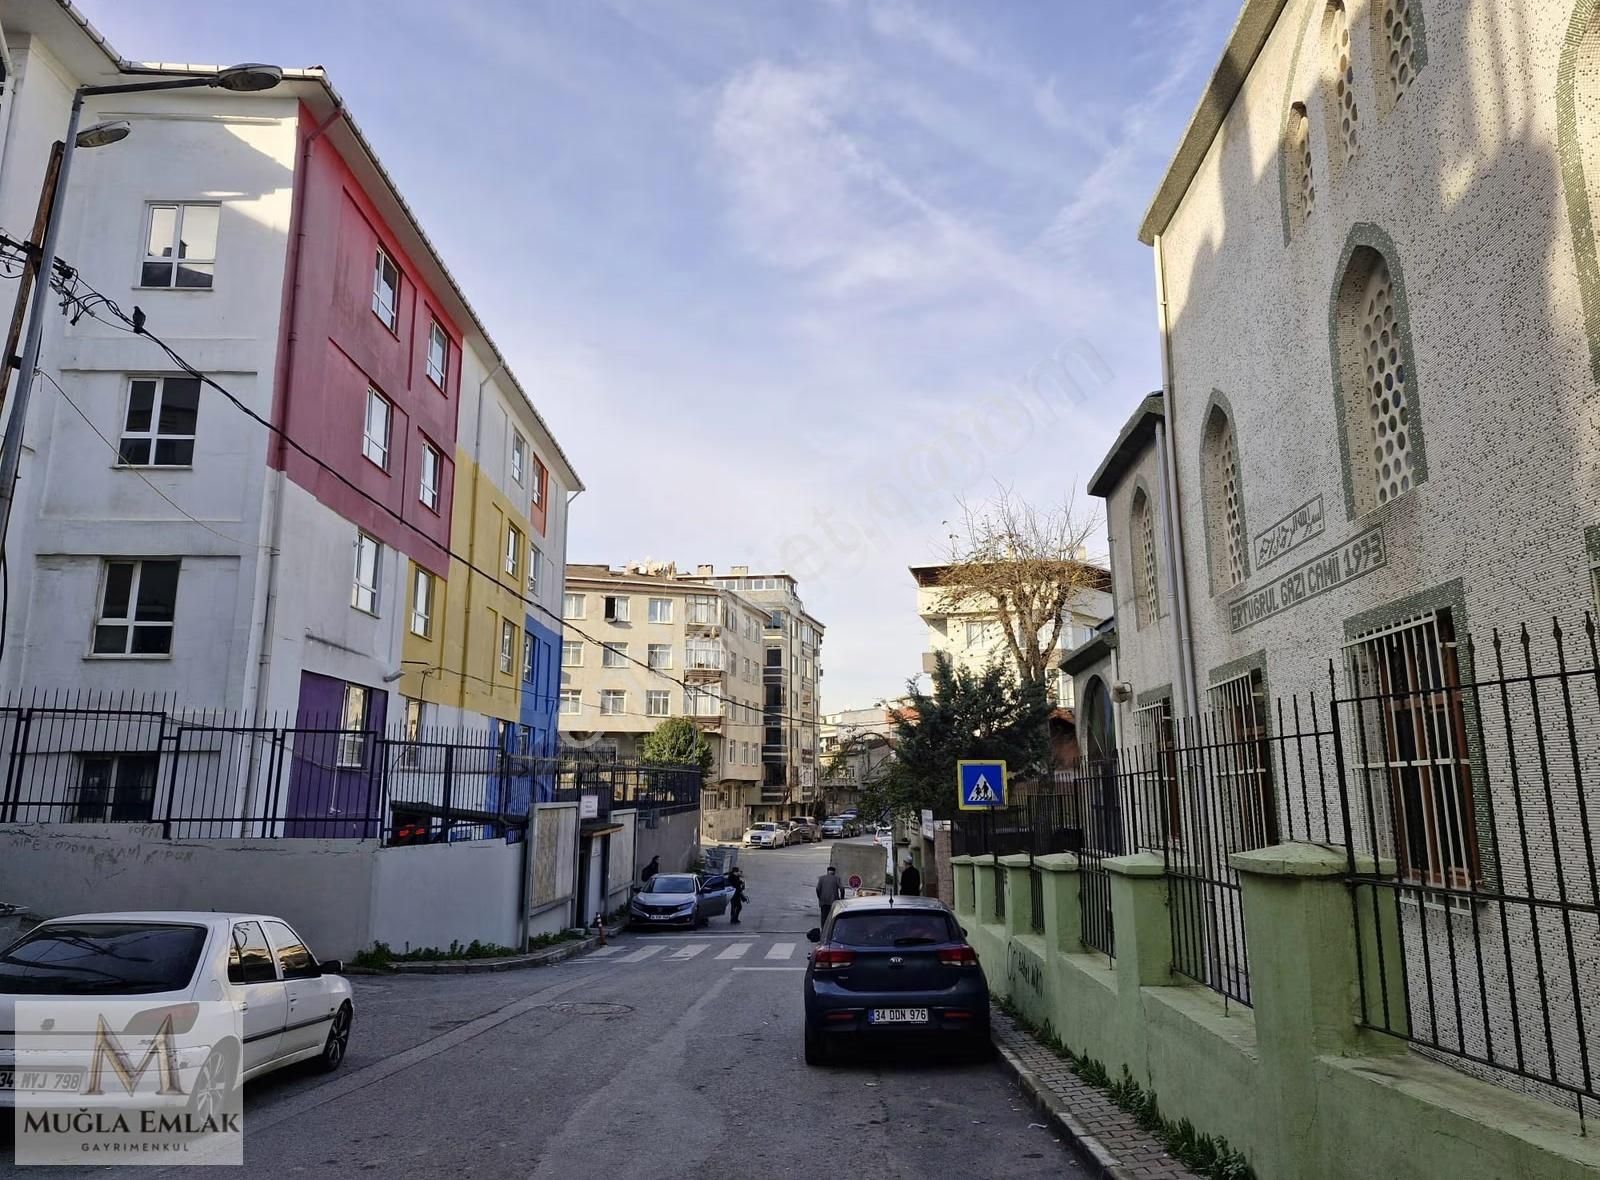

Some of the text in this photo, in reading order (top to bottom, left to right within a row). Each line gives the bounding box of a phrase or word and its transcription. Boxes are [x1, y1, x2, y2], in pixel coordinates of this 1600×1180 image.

[1343, 533, 1383, 578] 1973
[875, 1010, 886, 1021] 34
[910, 1010, 926, 1020] 976
[0, 1072, 14, 1088] 34
[54, 1073, 80, 1089] 798
